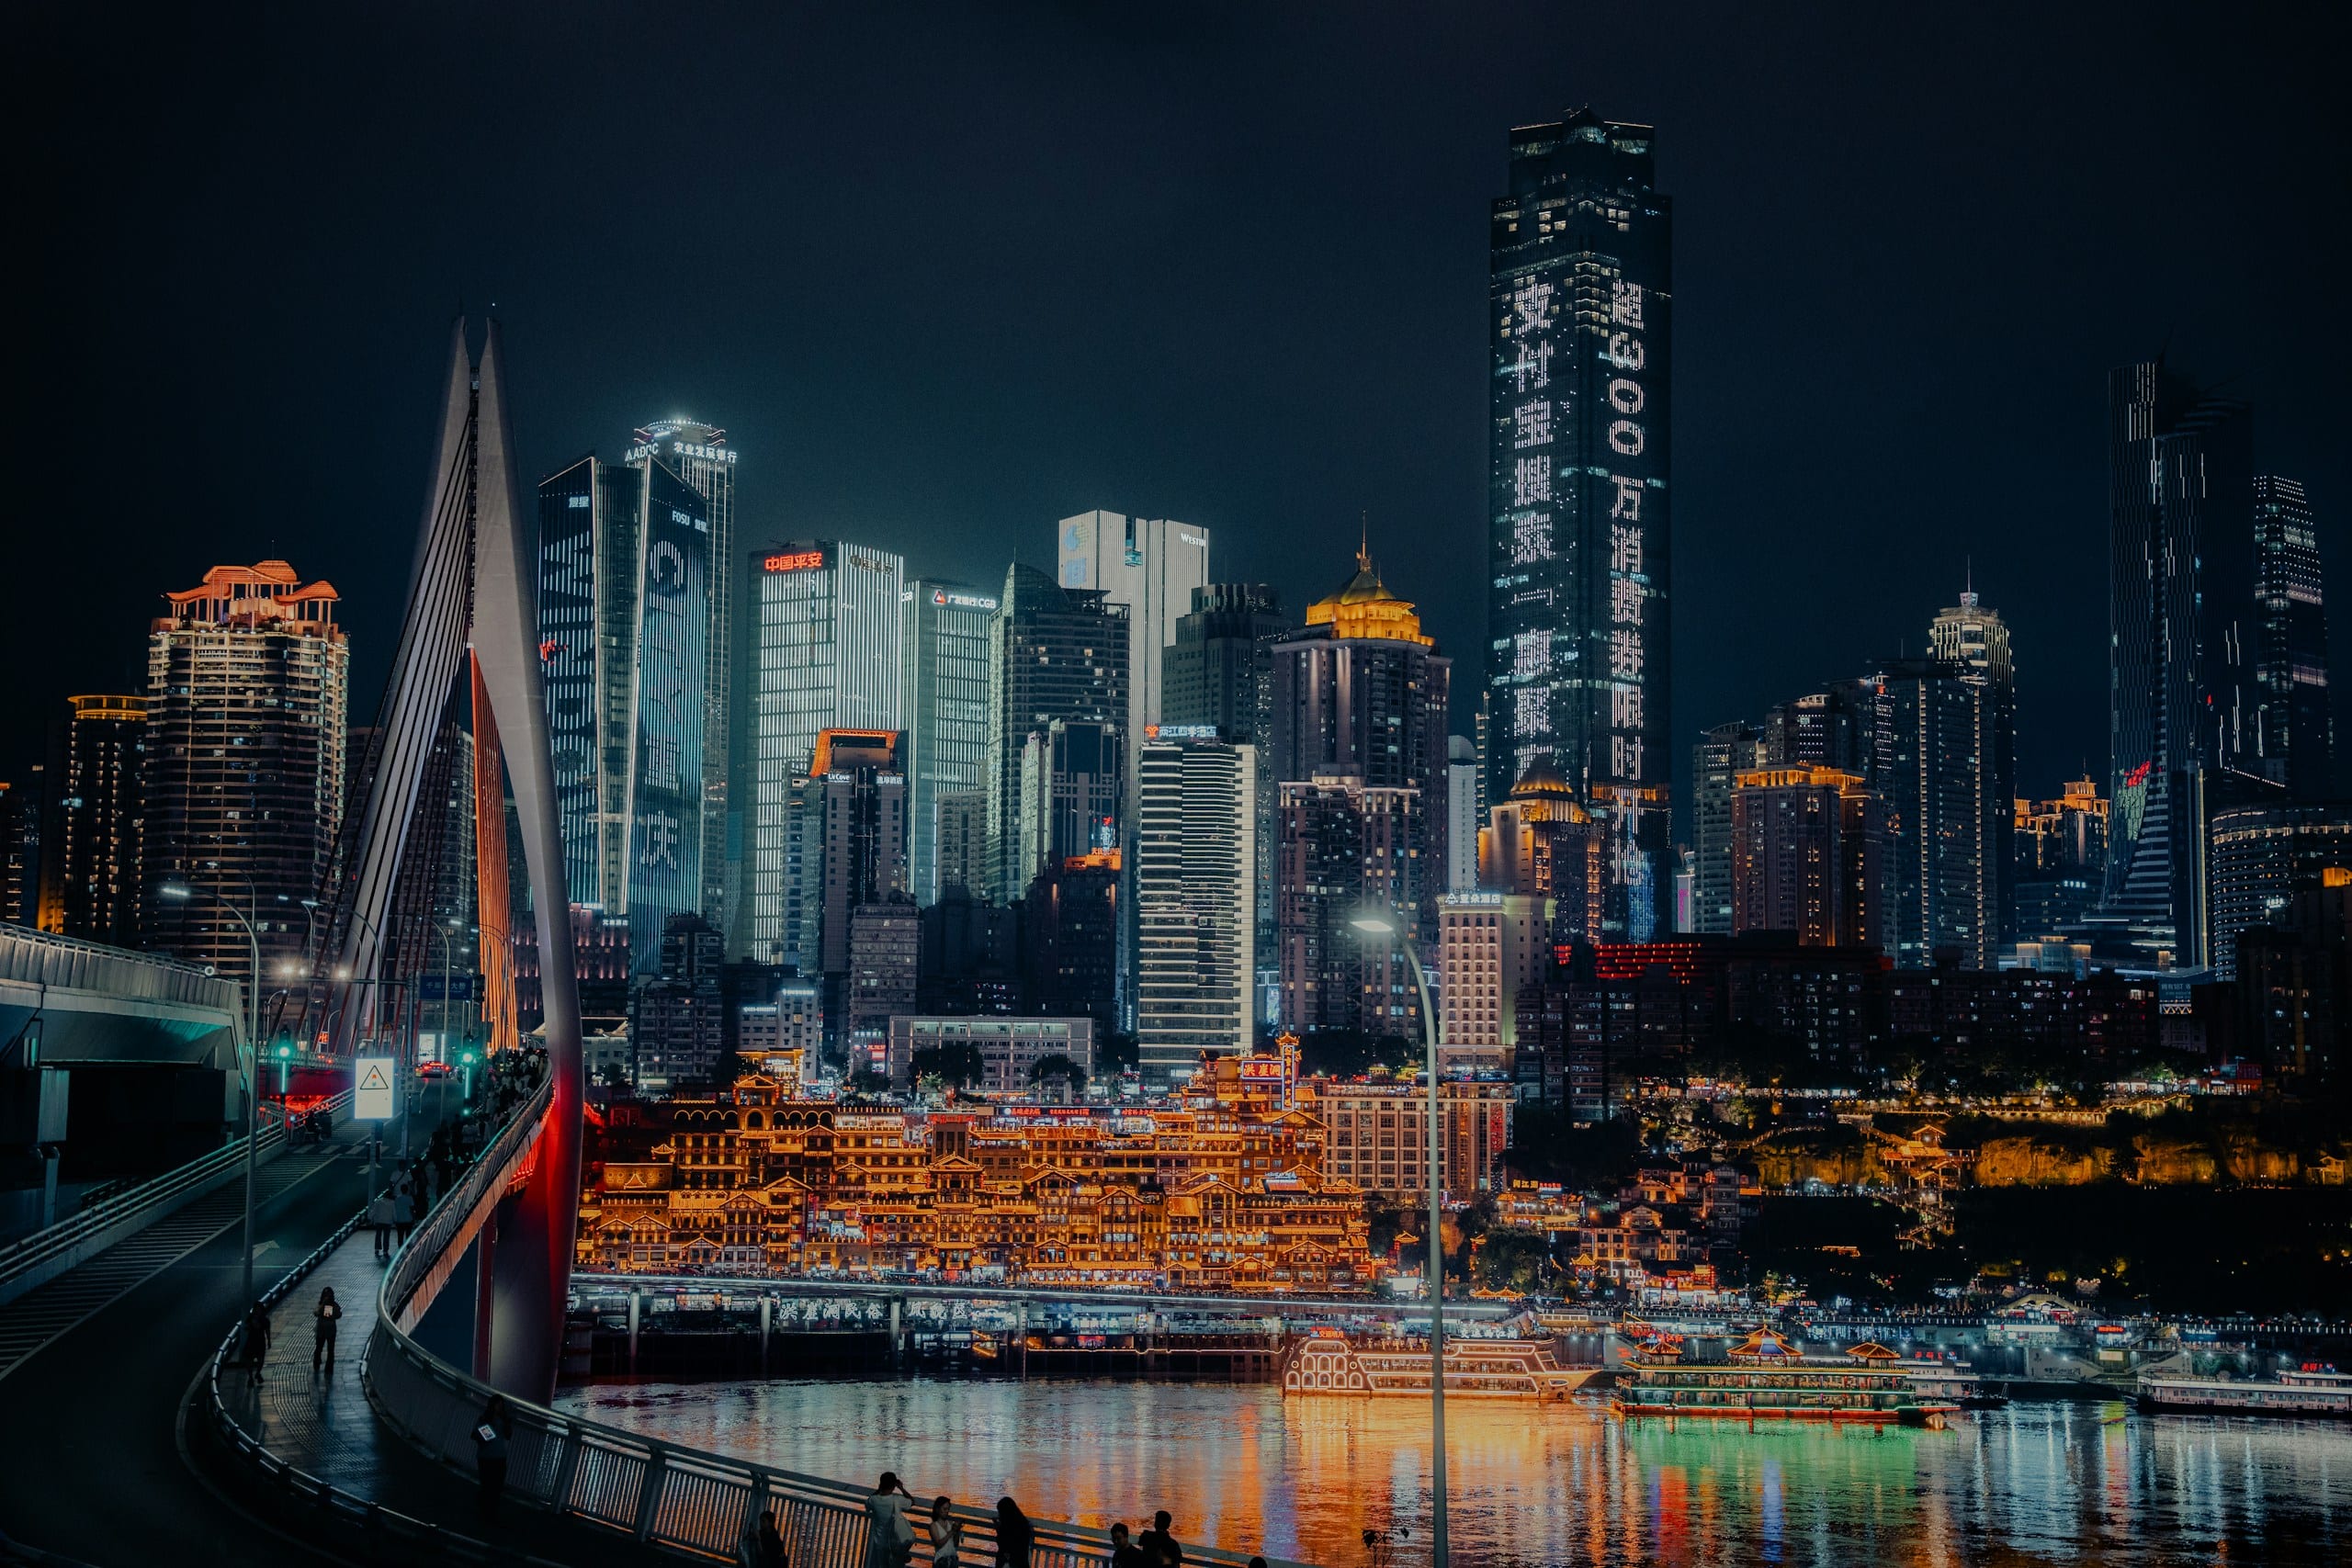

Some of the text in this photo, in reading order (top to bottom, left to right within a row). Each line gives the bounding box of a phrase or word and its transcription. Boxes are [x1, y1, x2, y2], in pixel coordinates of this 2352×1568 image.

[673, 441, 738, 464] 农业发展银行
[763, 551, 823, 572] 中国平安
[978, 598, 997, 609] CGB
[1243, 1064, 1282, 1077] 洪崖洞
